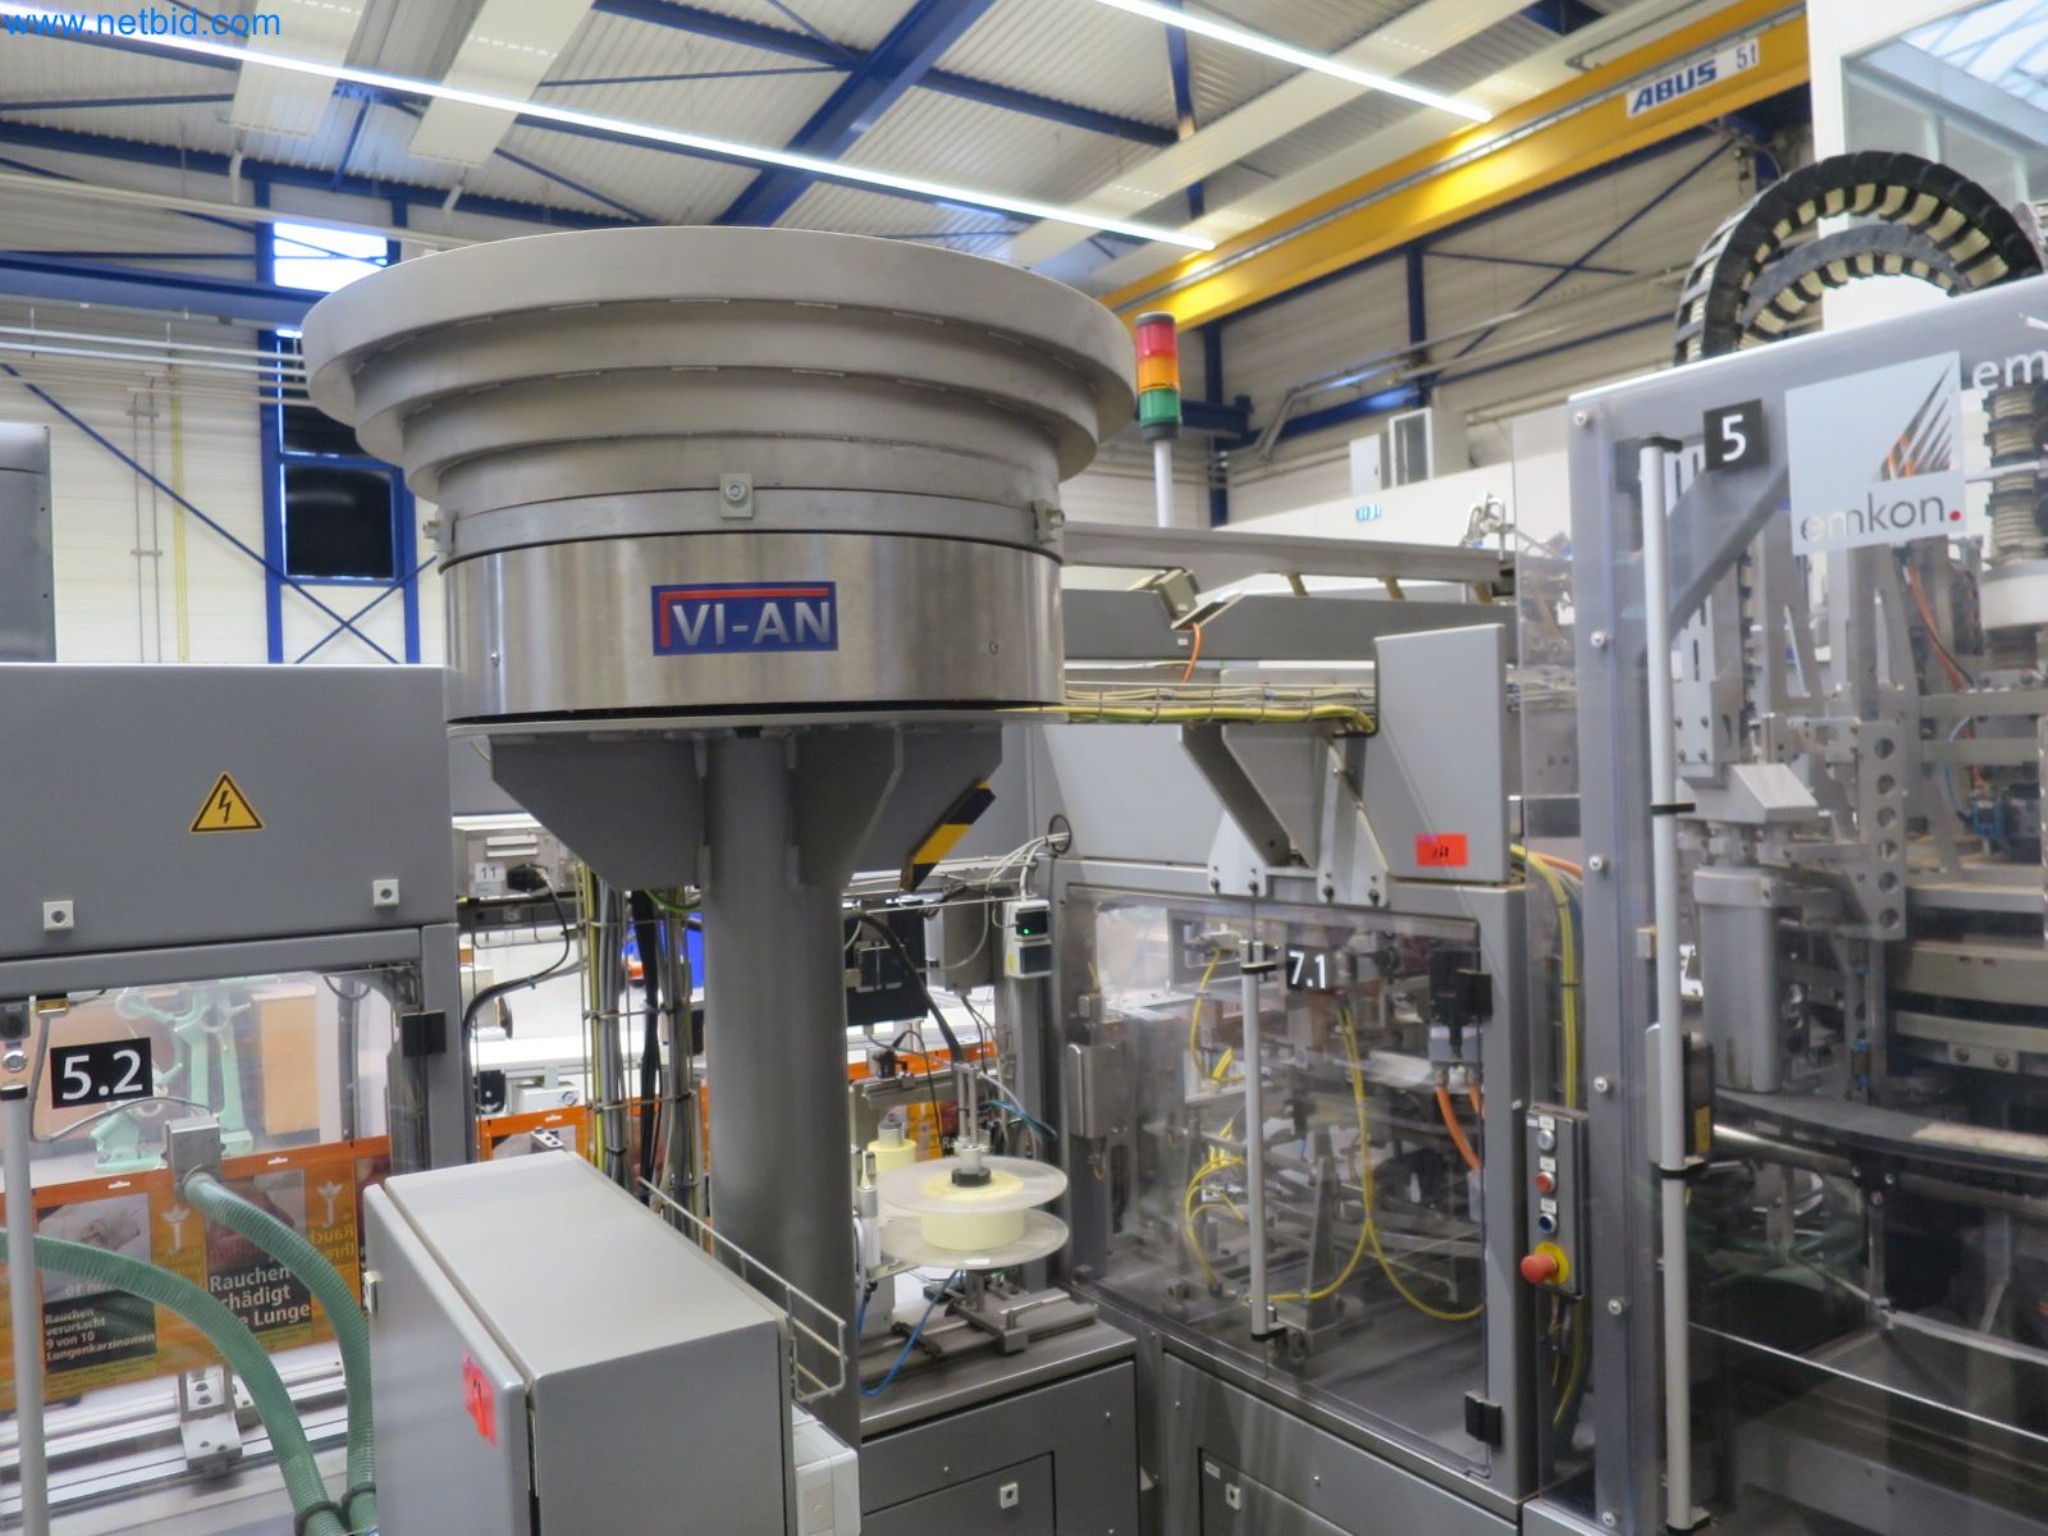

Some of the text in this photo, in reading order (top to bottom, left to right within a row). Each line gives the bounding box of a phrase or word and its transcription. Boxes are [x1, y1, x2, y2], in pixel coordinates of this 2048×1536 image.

[1631, 59, 1717, 114] ABUS
[1721, 414, 1747, 462] 5
[672, 602, 830, 647] VI-AN
[1288, 950, 1326, 989] 7.1
[62, 1049, 143, 1101] 5.2
[209, 1266, 291, 1293] Rauchen
[220, 1284, 291, 1310] hädigt
[44, 1309, 95, 1325] Rauchen
[46, 1317, 106, 1337] verursacht
[254, 1303, 311, 1327] Lunge
[45, 1331, 95, 1350] 9 von 10
[46, 1332, 156, 1361] Lungenkarzinomen
